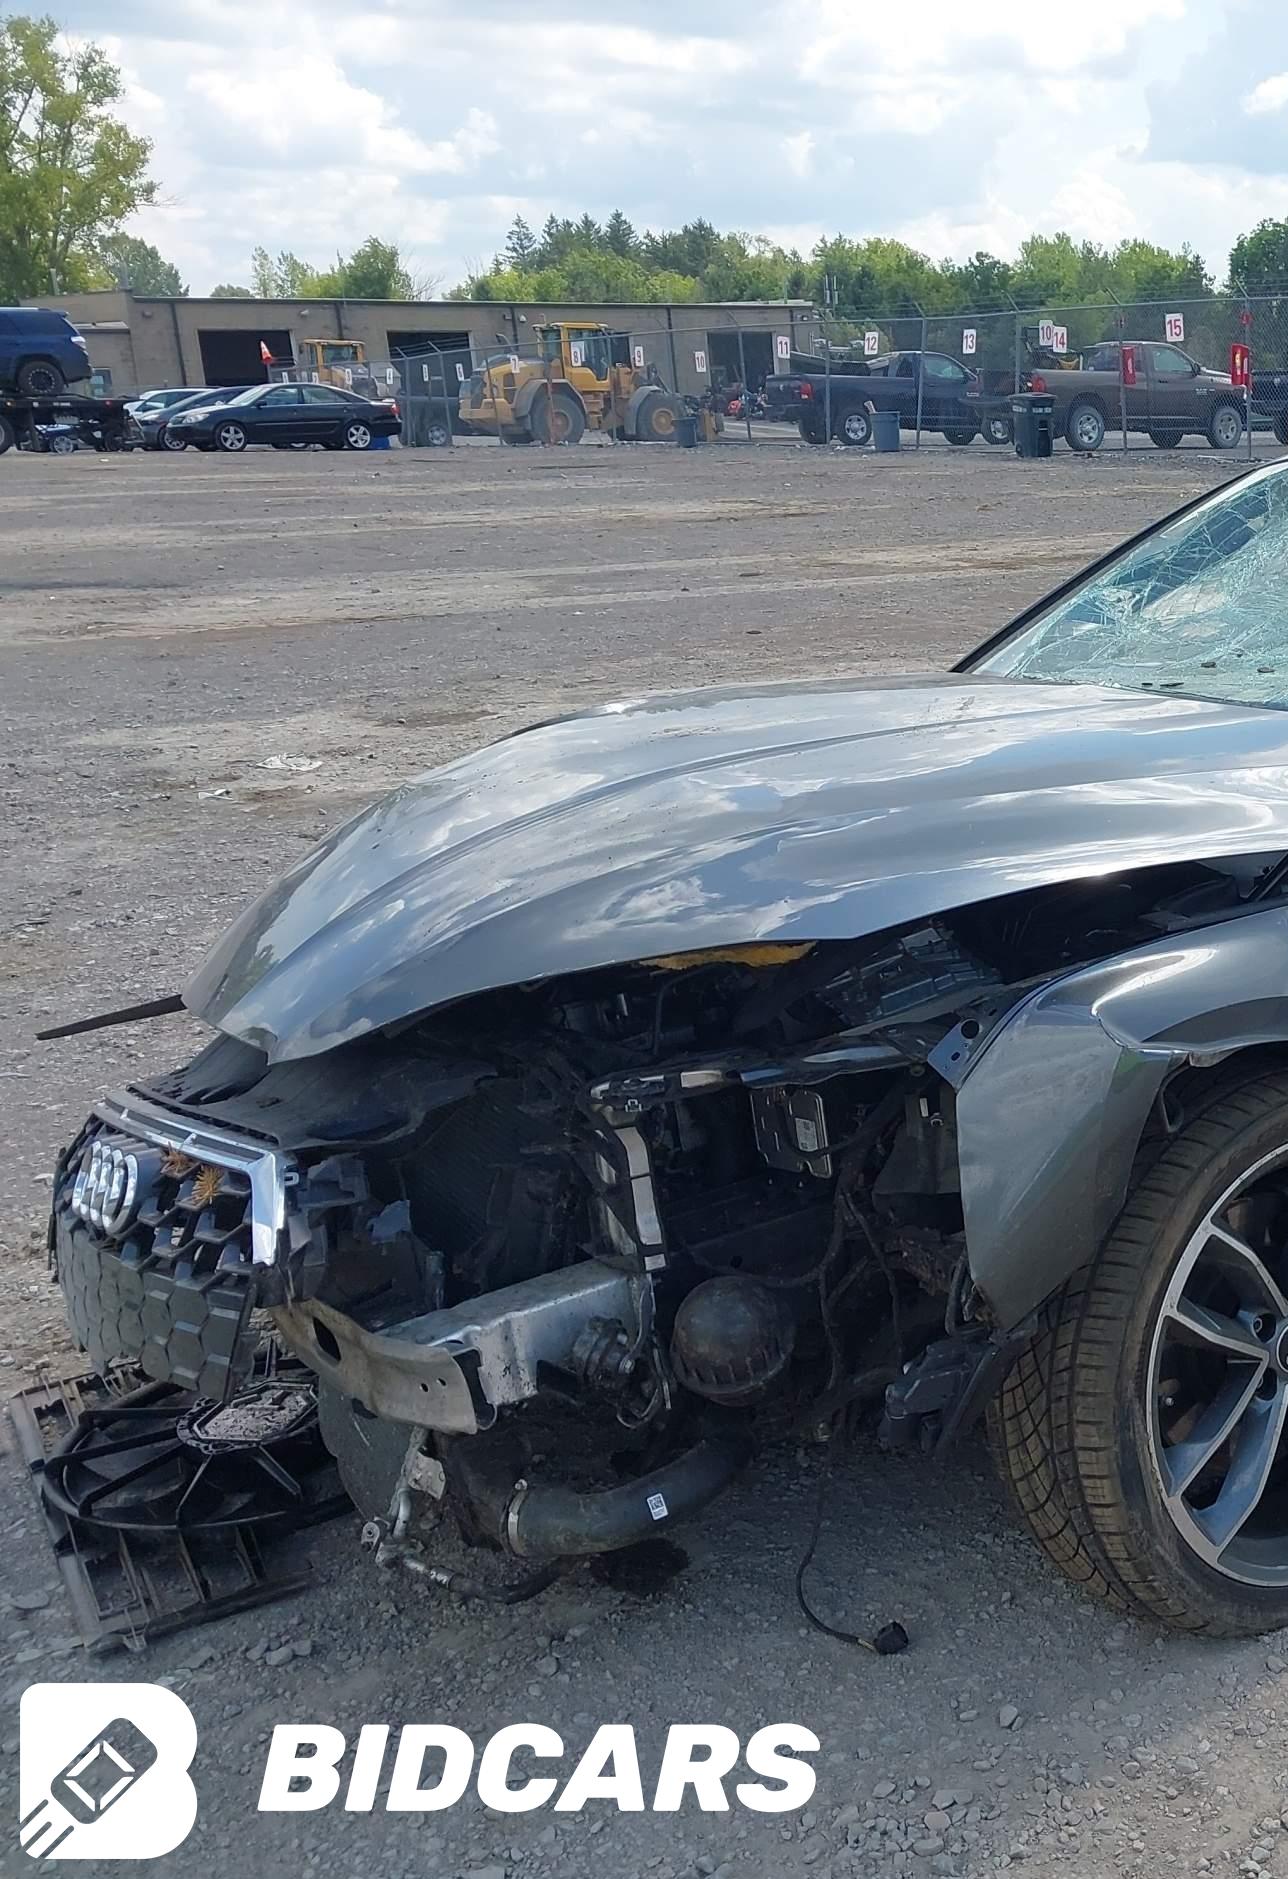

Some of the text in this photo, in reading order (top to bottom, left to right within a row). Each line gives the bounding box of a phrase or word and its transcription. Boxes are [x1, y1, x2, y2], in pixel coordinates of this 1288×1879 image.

[1041, 325, 1052, 341] 10
[1167, 319, 1182, 337] 15
[866, 336, 878, 351] 12
[964, 335, 975, 349] 13
[1054, 331, 1066, 348] 14
[778, 341, 789, 355] 11
[696, 356, 706, 370] 10
